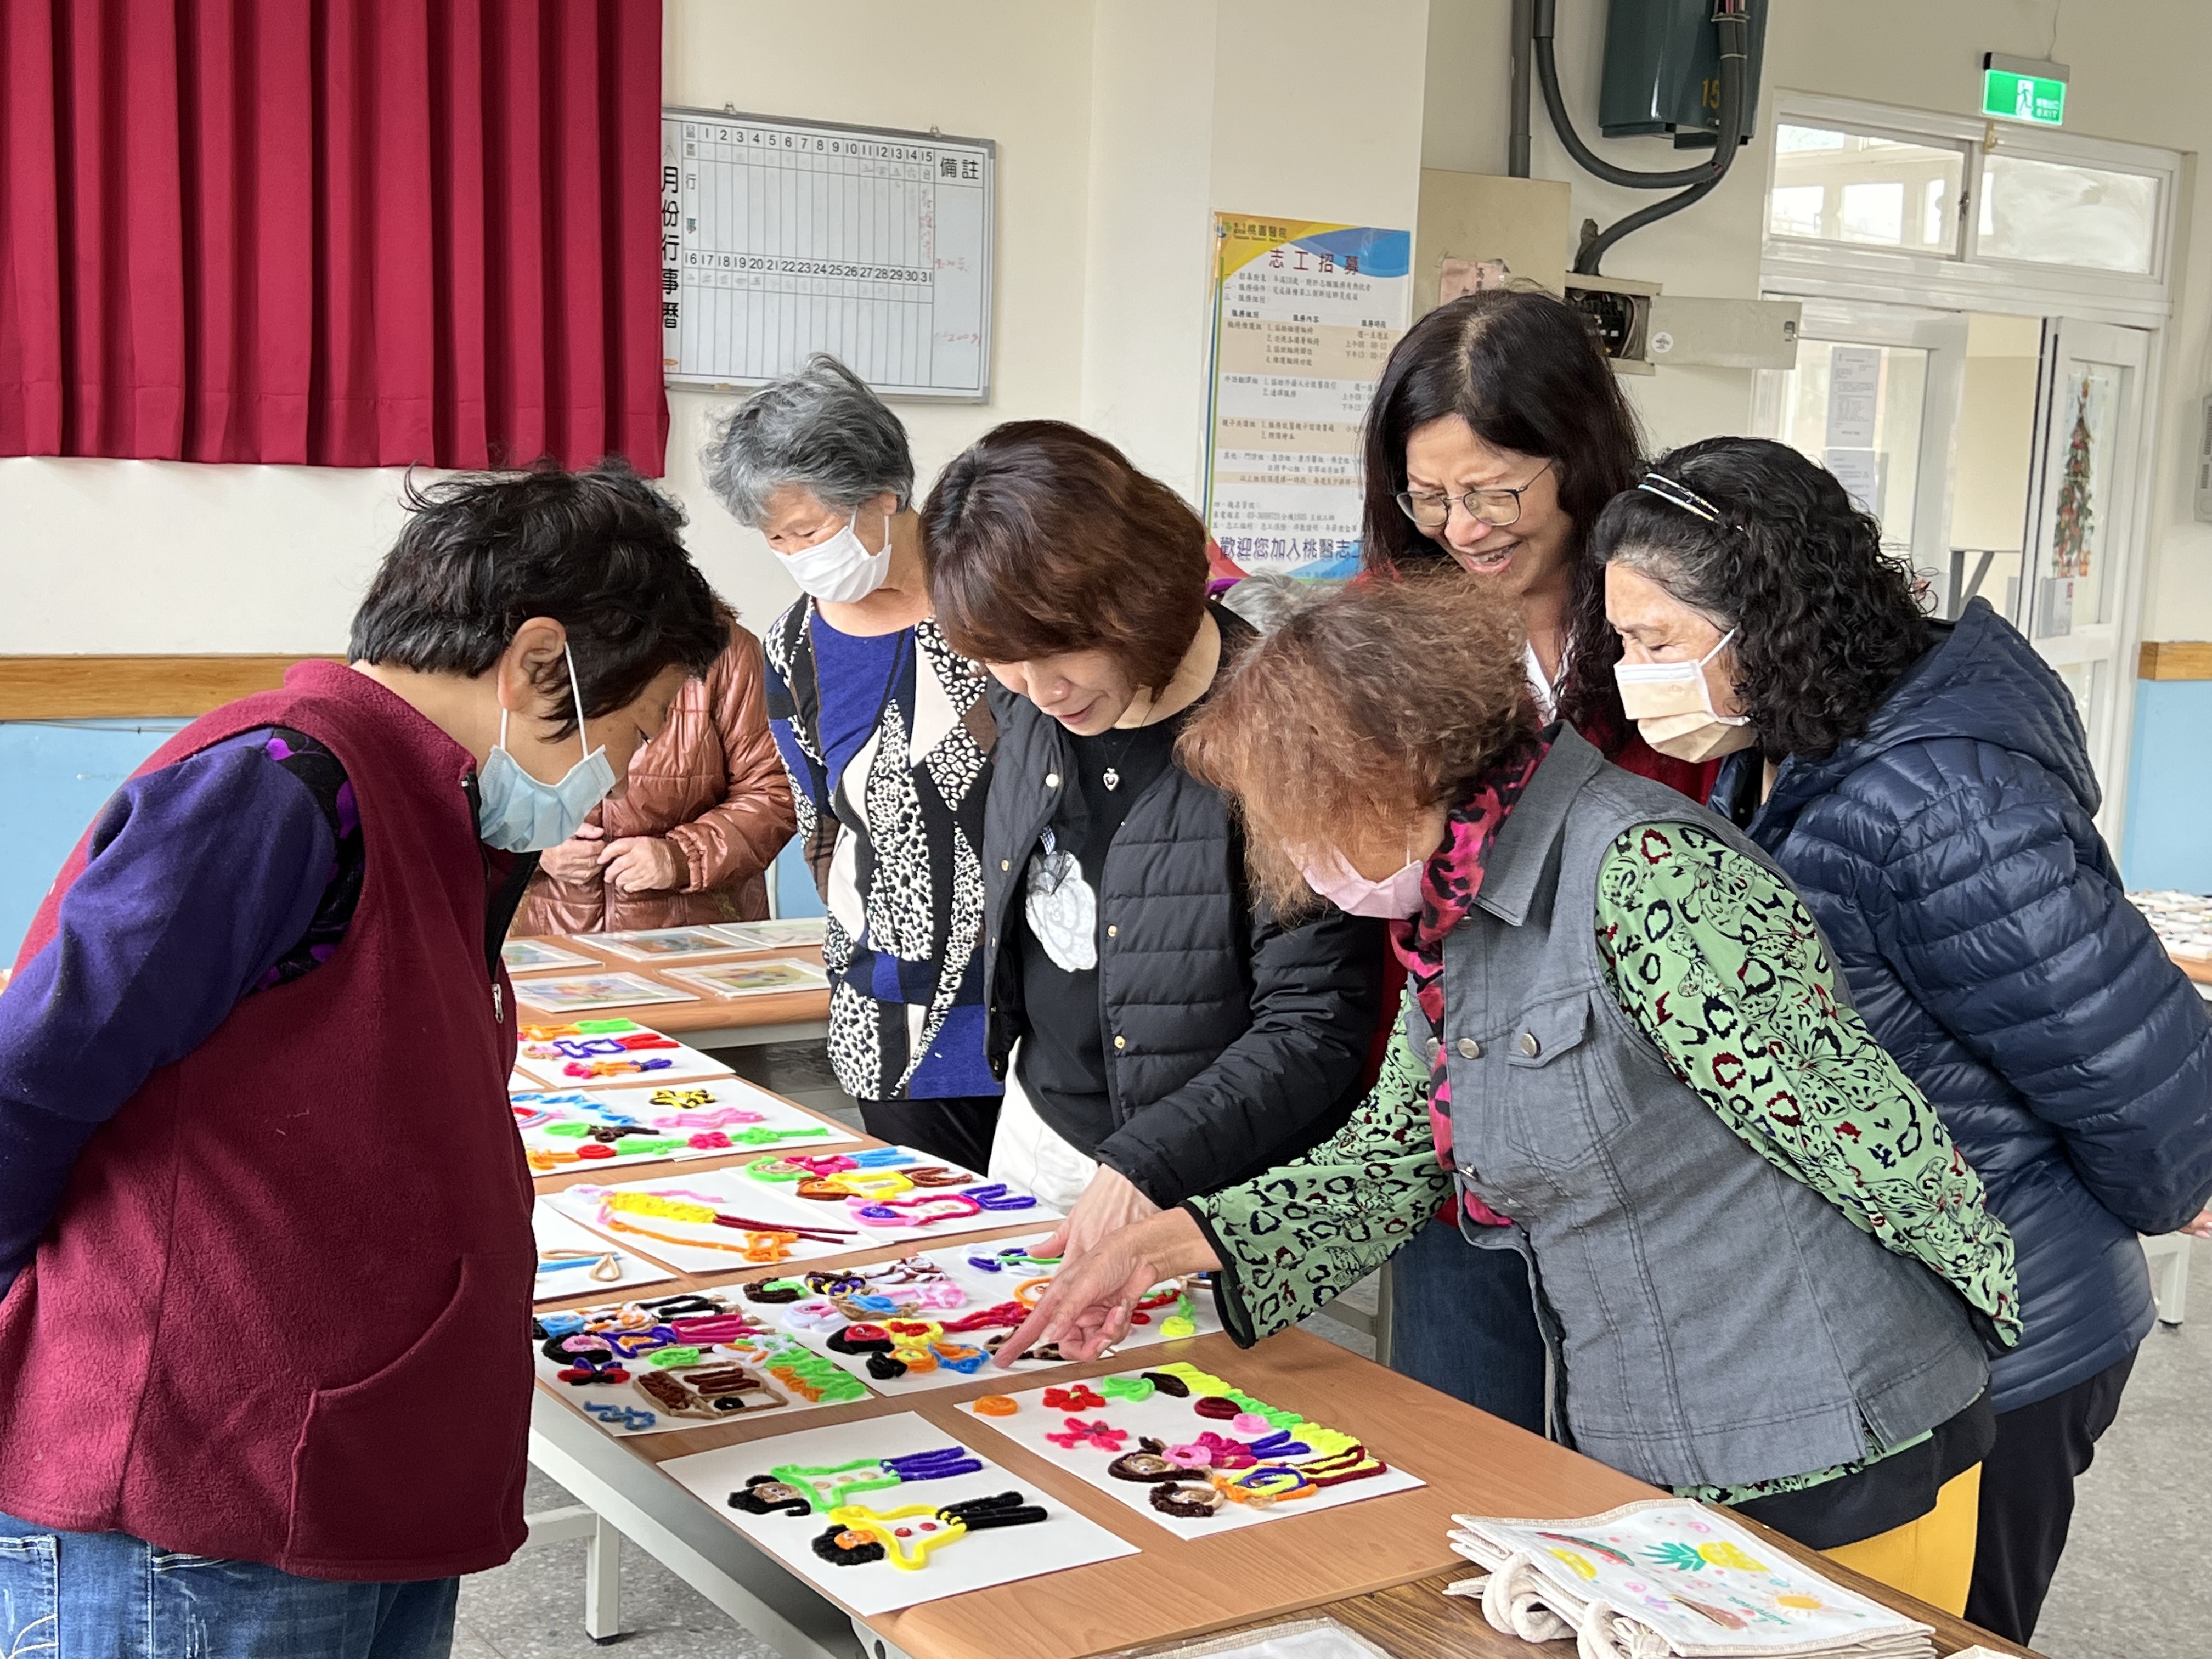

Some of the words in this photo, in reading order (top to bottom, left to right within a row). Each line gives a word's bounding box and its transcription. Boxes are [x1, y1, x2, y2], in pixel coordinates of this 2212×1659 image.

[720, 129, 727, 141] 2
[737, 131, 744, 143] 3
[752, 133, 760, 144] 4
[769, 135, 776, 146] 5
[785, 136, 792, 148] 6
[801, 138, 808, 149] 7
[817, 140, 823, 151] 8
[832, 141, 839, 153] 9
[845, 143, 857, 154] 10
[862, 145, 872, 156] 11
[876, 146, 888, 158] 12
[891, 148, 902, 159] 13
[906, 149, 917, 160] 14
[921, 151, 933, 162] 15
[940, 156, 979, 179] 備註
[685, 252, 697, 264] 16
[702, 254, 714, 266] 17
[718, 256, 730, 267] 18
[734, 257, 746, 268] 19
[749, 258, 764, 269] 20
[766, 259, 778, 270] 21
[781, 261, 795, 272] 22
[798, 262, 811, 273] 23
[813, 263, 827, 274] 24
[829, 264, 843, 275] 25
[844, 266, 858, 276] 26
[860, 267, 872, 278] 27
[874, 268, 888, 279] 28
[890, 269, 903, 280] 29
[905, 270, 918, 281] 30
[920, 272, 932, 283] 31
[1269, 249, 1359, 275] 志工招募
